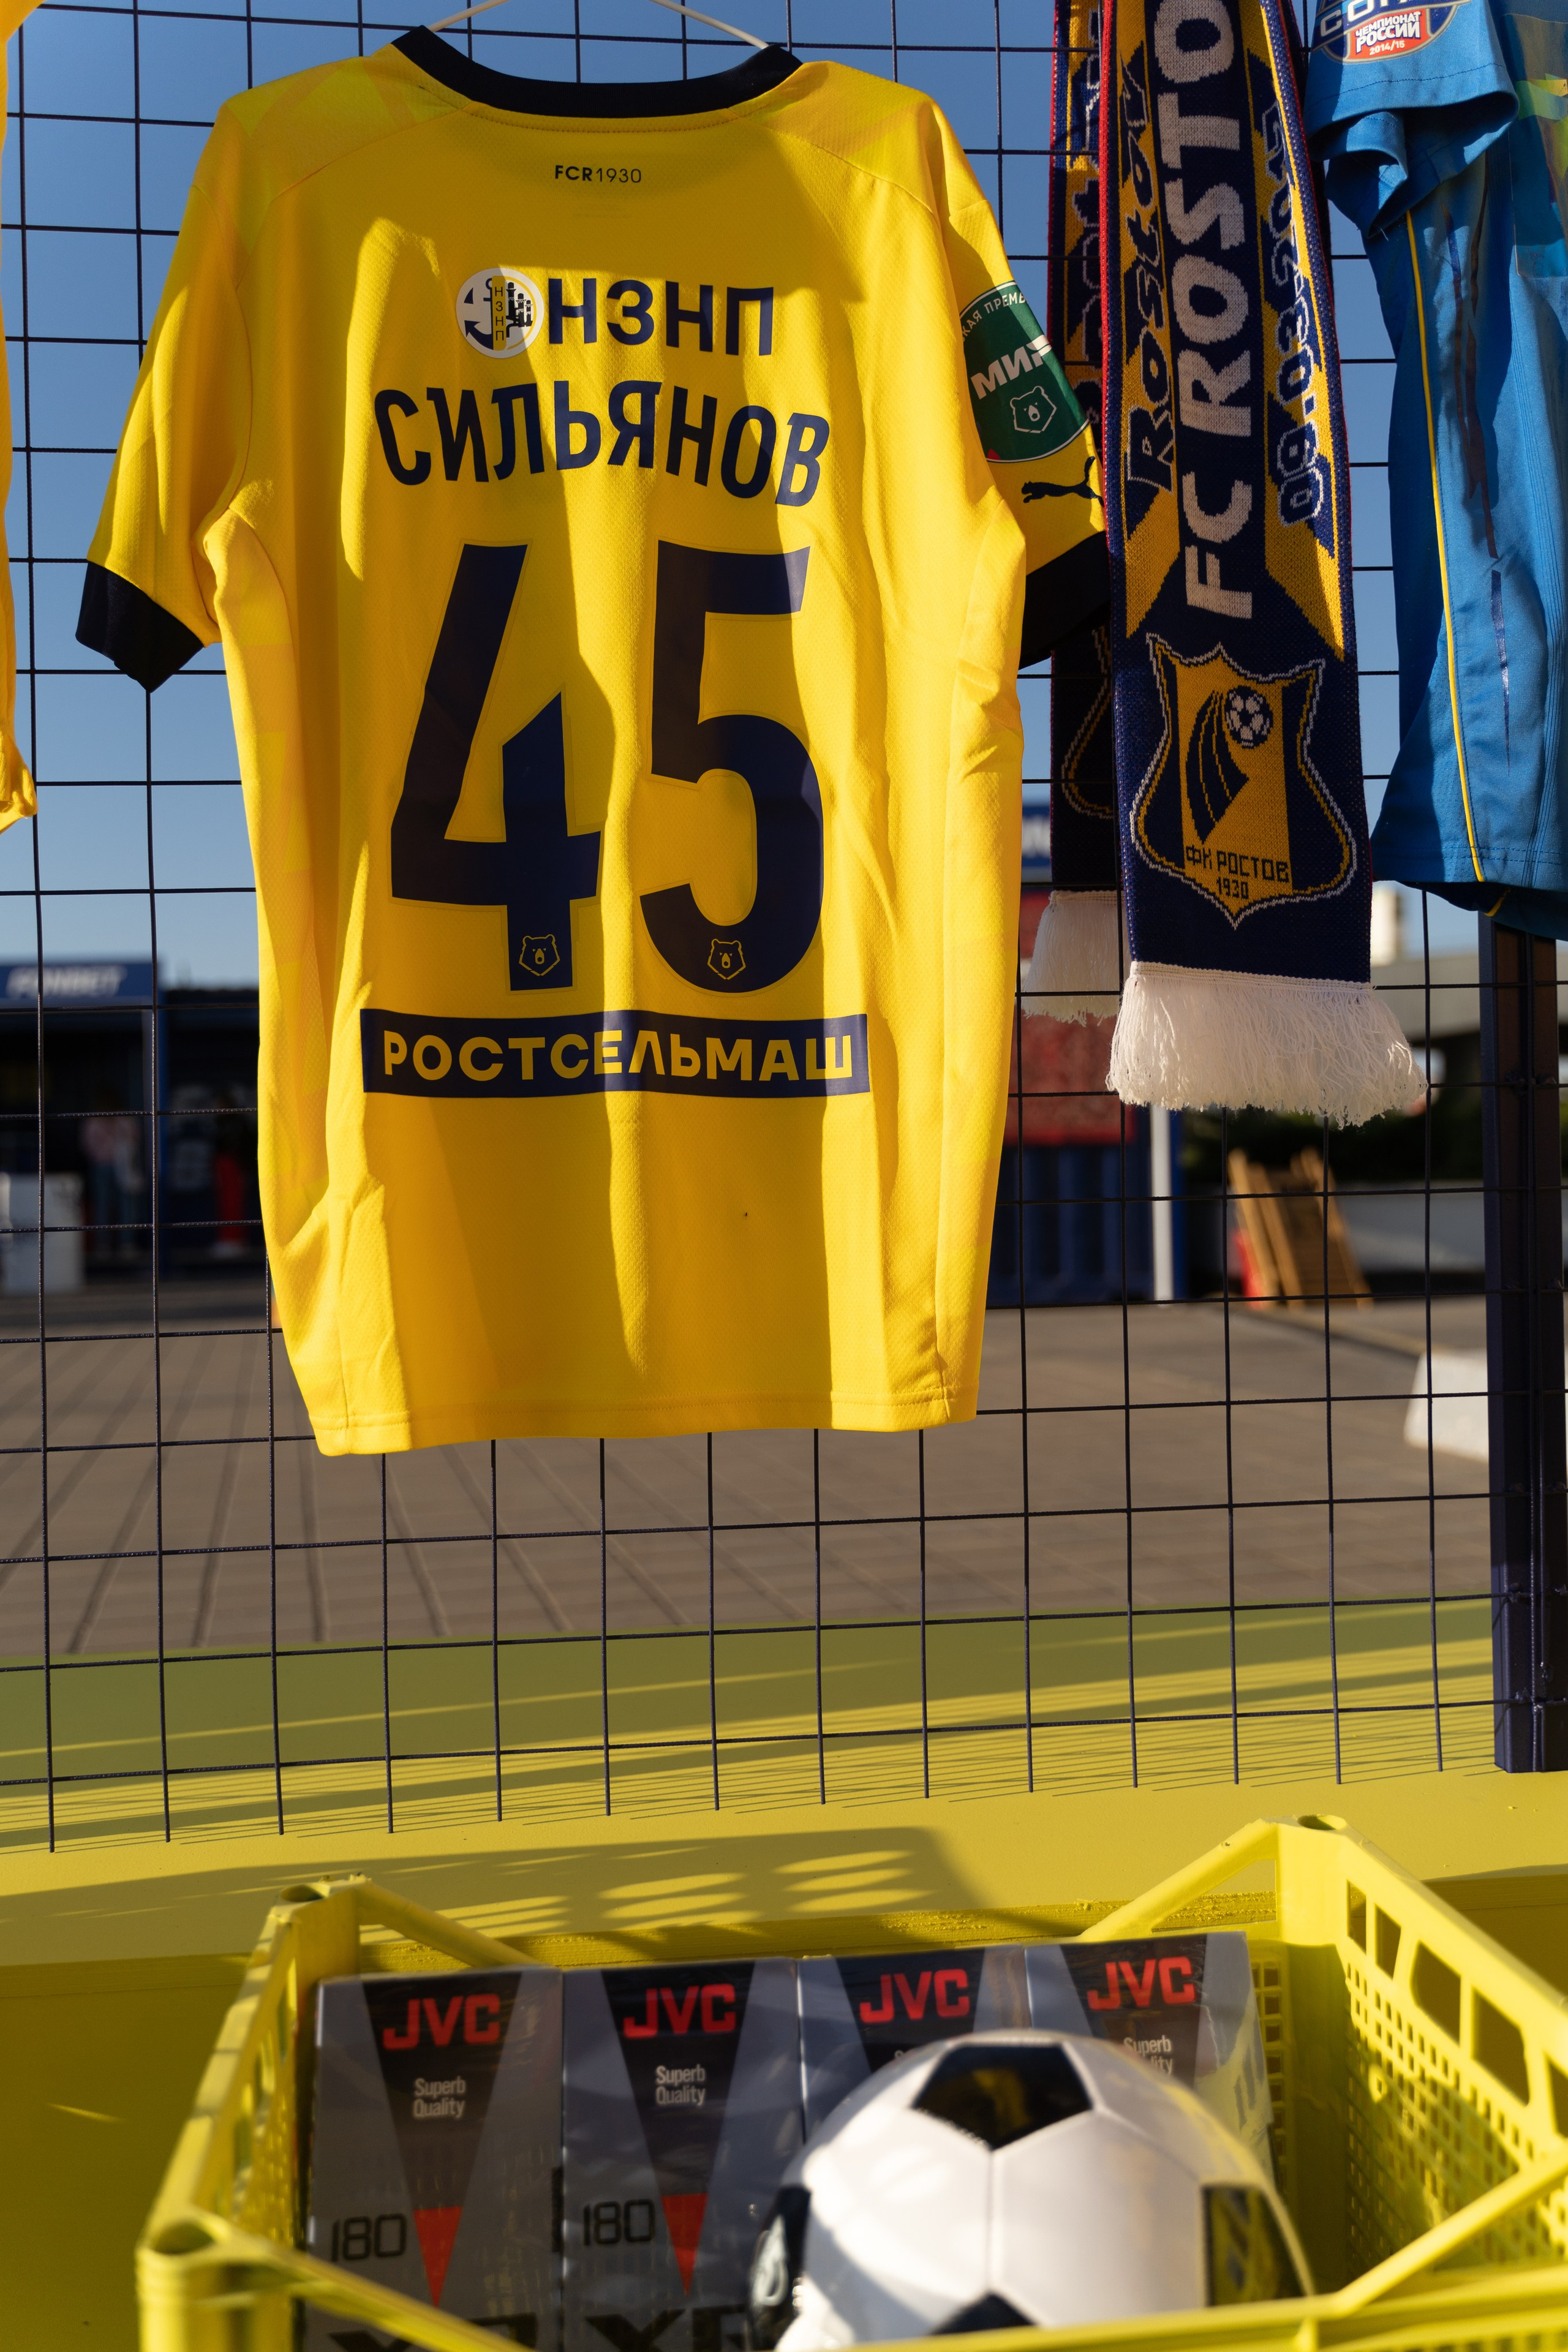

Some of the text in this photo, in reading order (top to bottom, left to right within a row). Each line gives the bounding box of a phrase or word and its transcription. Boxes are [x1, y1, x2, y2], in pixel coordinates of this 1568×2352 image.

[1355, 12, 1422, 38] ЧЕМПИОНАТ
[1355, 21, 1422, 54] РОССИИ
[1369, 40, 1405, 56] 2014/15
[555, 165, 641, 183] FCR1930
[1120, 52, 1176, 495] Rostov
[548, 277, 774, 356] НЗНП
[962, 310, 982, 342] КАЯ
[374, 380, 830, 507] СИЛЬЯНОВ
[1182, 471, 1253, 619] FC
[390, 540, 824, 993] 45
[1186, 845, 1289, 883] ФК РОСТОВ
[1216, 876, 1249, 900] 1930
[383, 1029, 853, 1082] РОСТСЕЛЬМАШ
[859, 1968, 971, 2024] JVC
[1087, 1956, 1196, 2011] JVC
[382, 1993, 500, 2050] JVC
[624, 1983, 736, 2038] JVC
[1123, 2035, 1172, 2057] Superb
[414, 2075, 467, 2099] Superb
[655, 2064, 707, 2086] Superb
[655, 2084, 706, 2106] Quality
[412, 2097, 466, 2119] Quality
[331, 2212, 408, 2263] 180
[582, 2198, 656, 2247] 180
